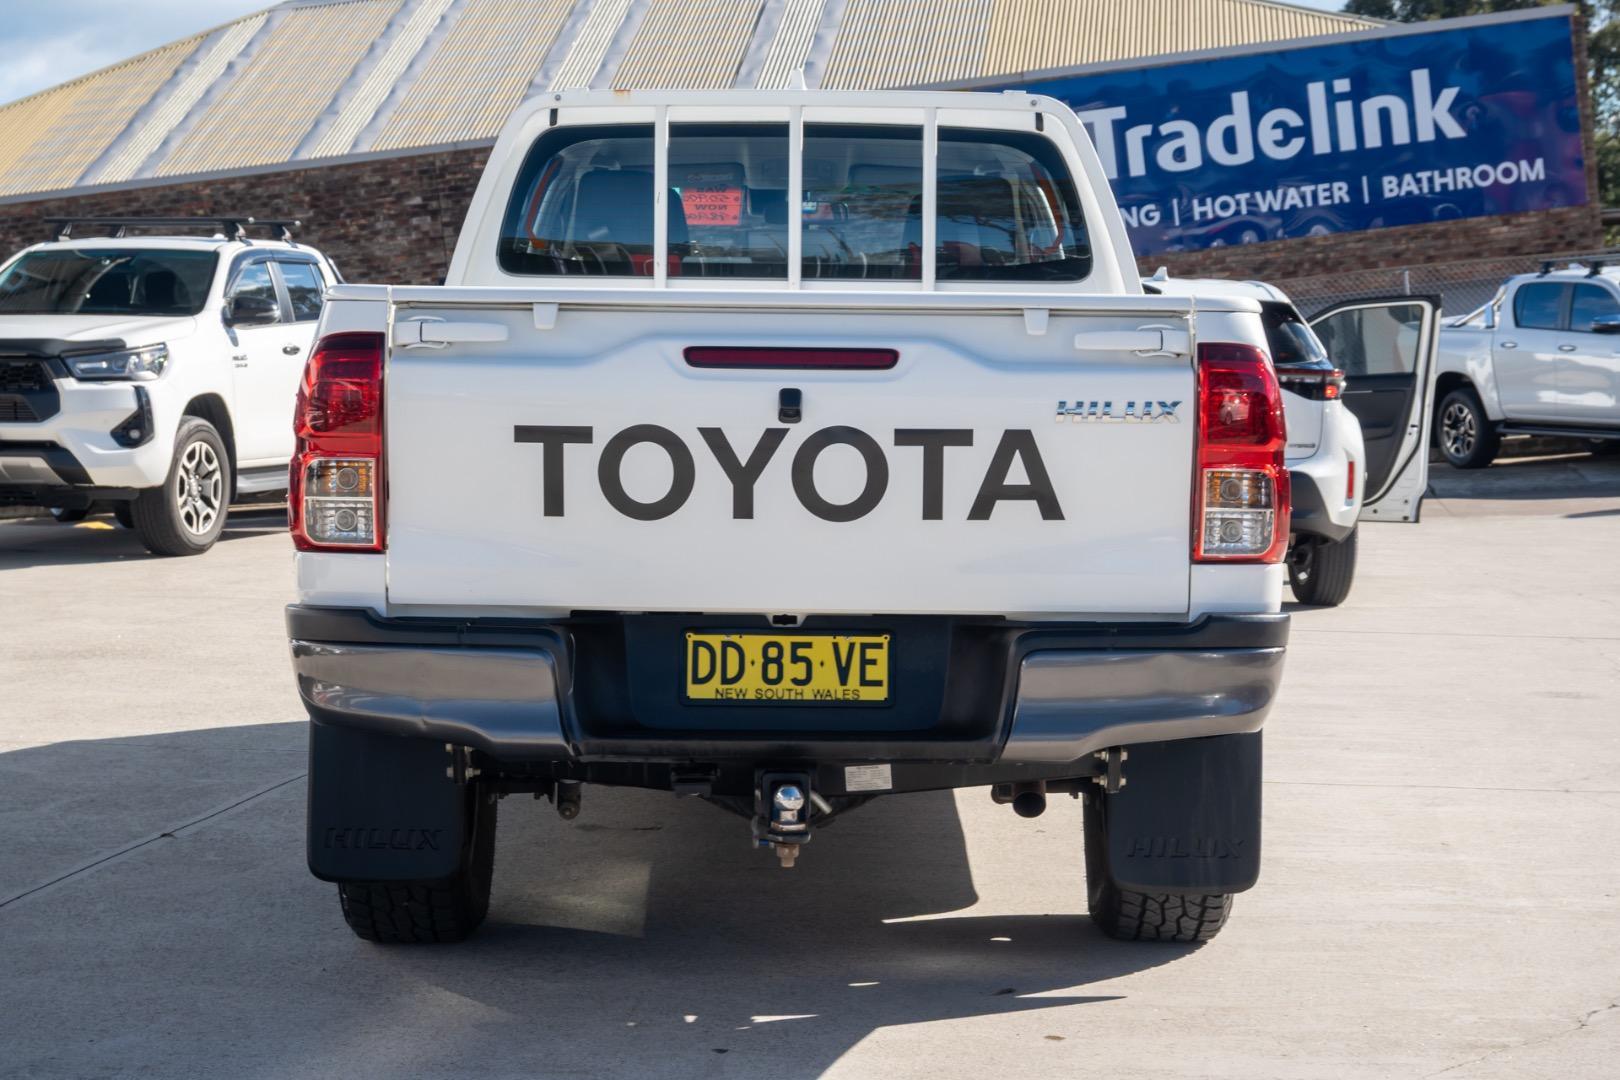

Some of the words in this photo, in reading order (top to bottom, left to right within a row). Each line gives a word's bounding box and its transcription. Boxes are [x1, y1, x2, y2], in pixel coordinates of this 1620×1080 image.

[1078, 69, 1466, 179] Tradelink
[1193, 194, 1251, 222] HOT
[1255, 182, 1349, 211] WATER
[1382, 158, 1545, 198] BATHROOM
[1055, 401, 1182, 423] HILUX
[514, 424, 1065, 522] TOYOTA
[715, 688, 748, 700] NEW
[754, 688, 804, 700] SOUTH
[812, 688, 861, 701] WALES
[324, 828, 447, 851] HILUX
[1127, 837, 1245, 859] HILUX
